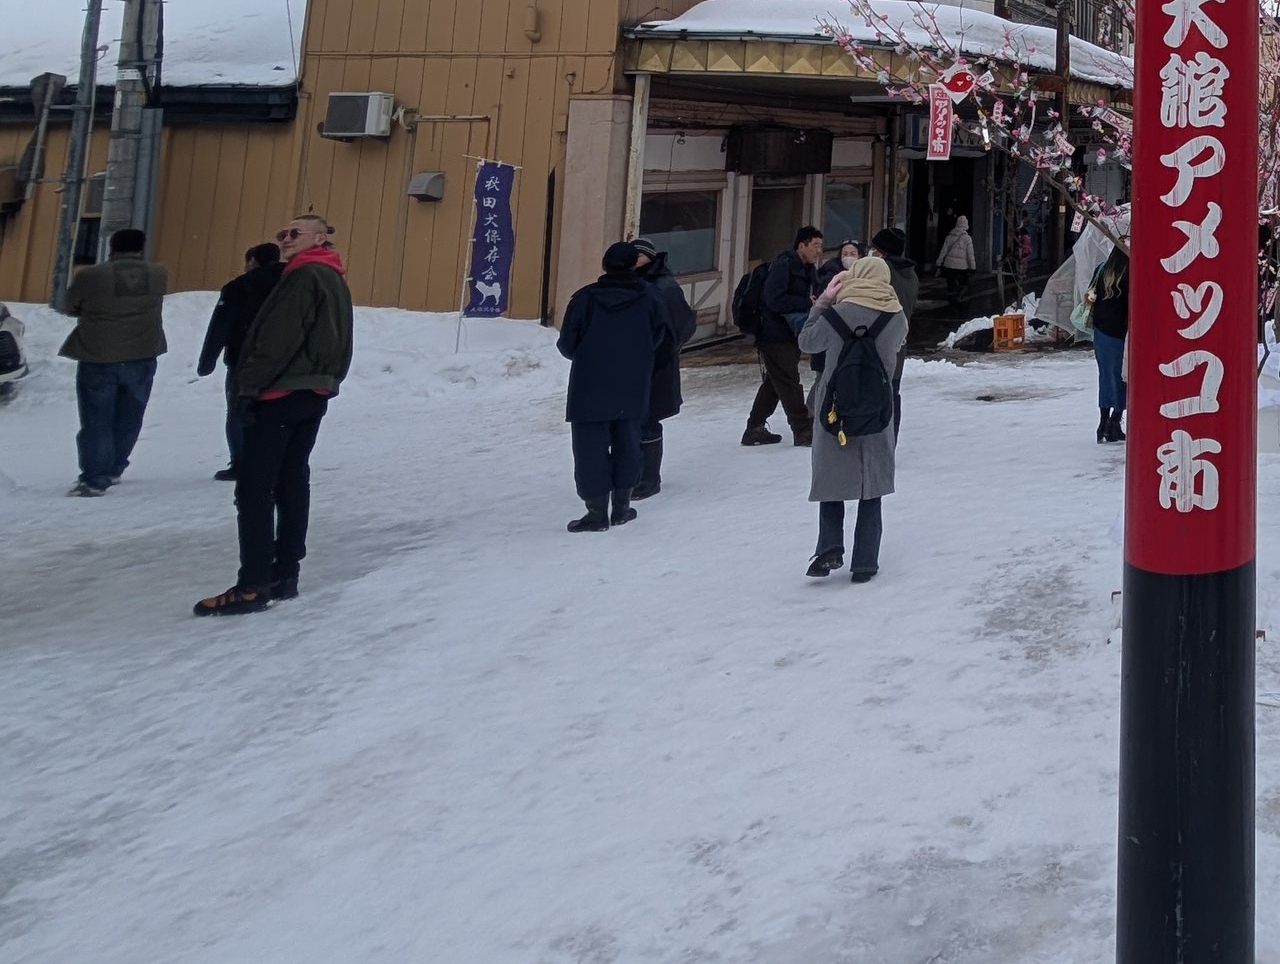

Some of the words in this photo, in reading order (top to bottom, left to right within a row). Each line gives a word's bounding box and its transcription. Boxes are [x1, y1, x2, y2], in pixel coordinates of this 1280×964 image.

[481, 176, 501, 281] 秋田犬保存会
